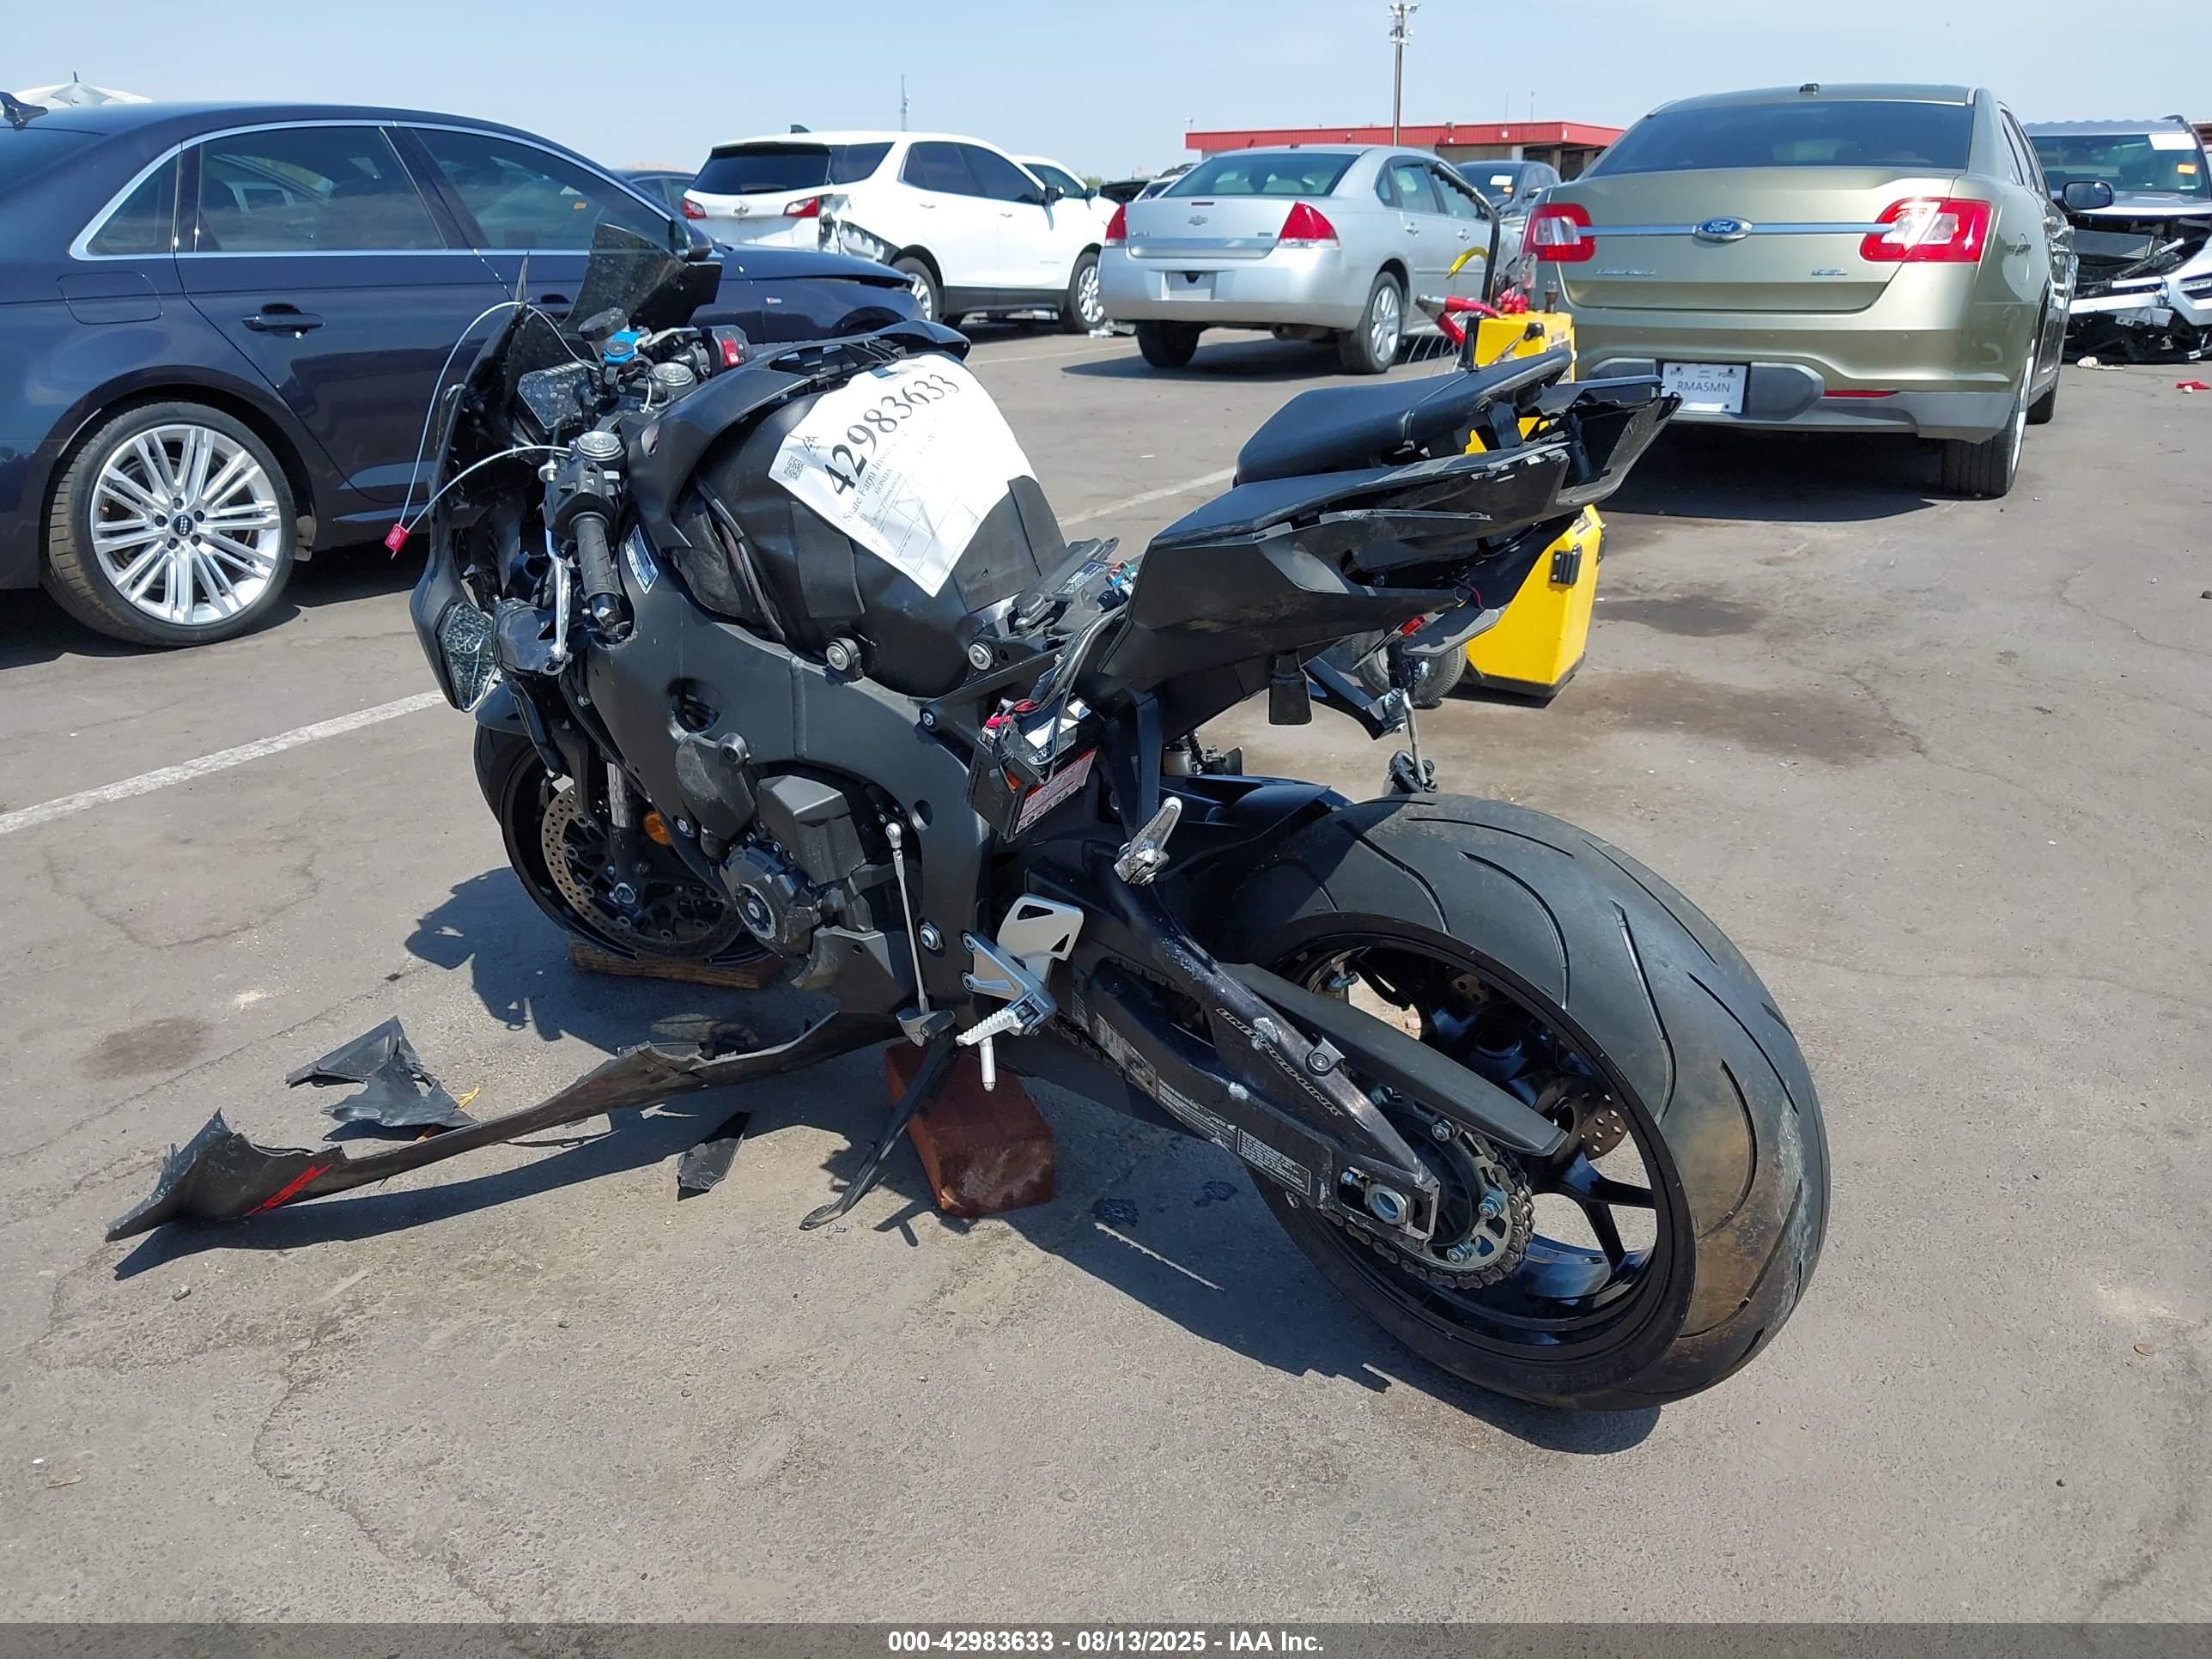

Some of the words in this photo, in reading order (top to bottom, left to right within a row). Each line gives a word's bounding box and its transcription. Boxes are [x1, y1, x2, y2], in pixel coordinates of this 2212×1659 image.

[1708, 221, 1734, 232] Ford
[1677, 380, 1730, 392] RMASMN
[824, 374, 959, 496] 42983633
